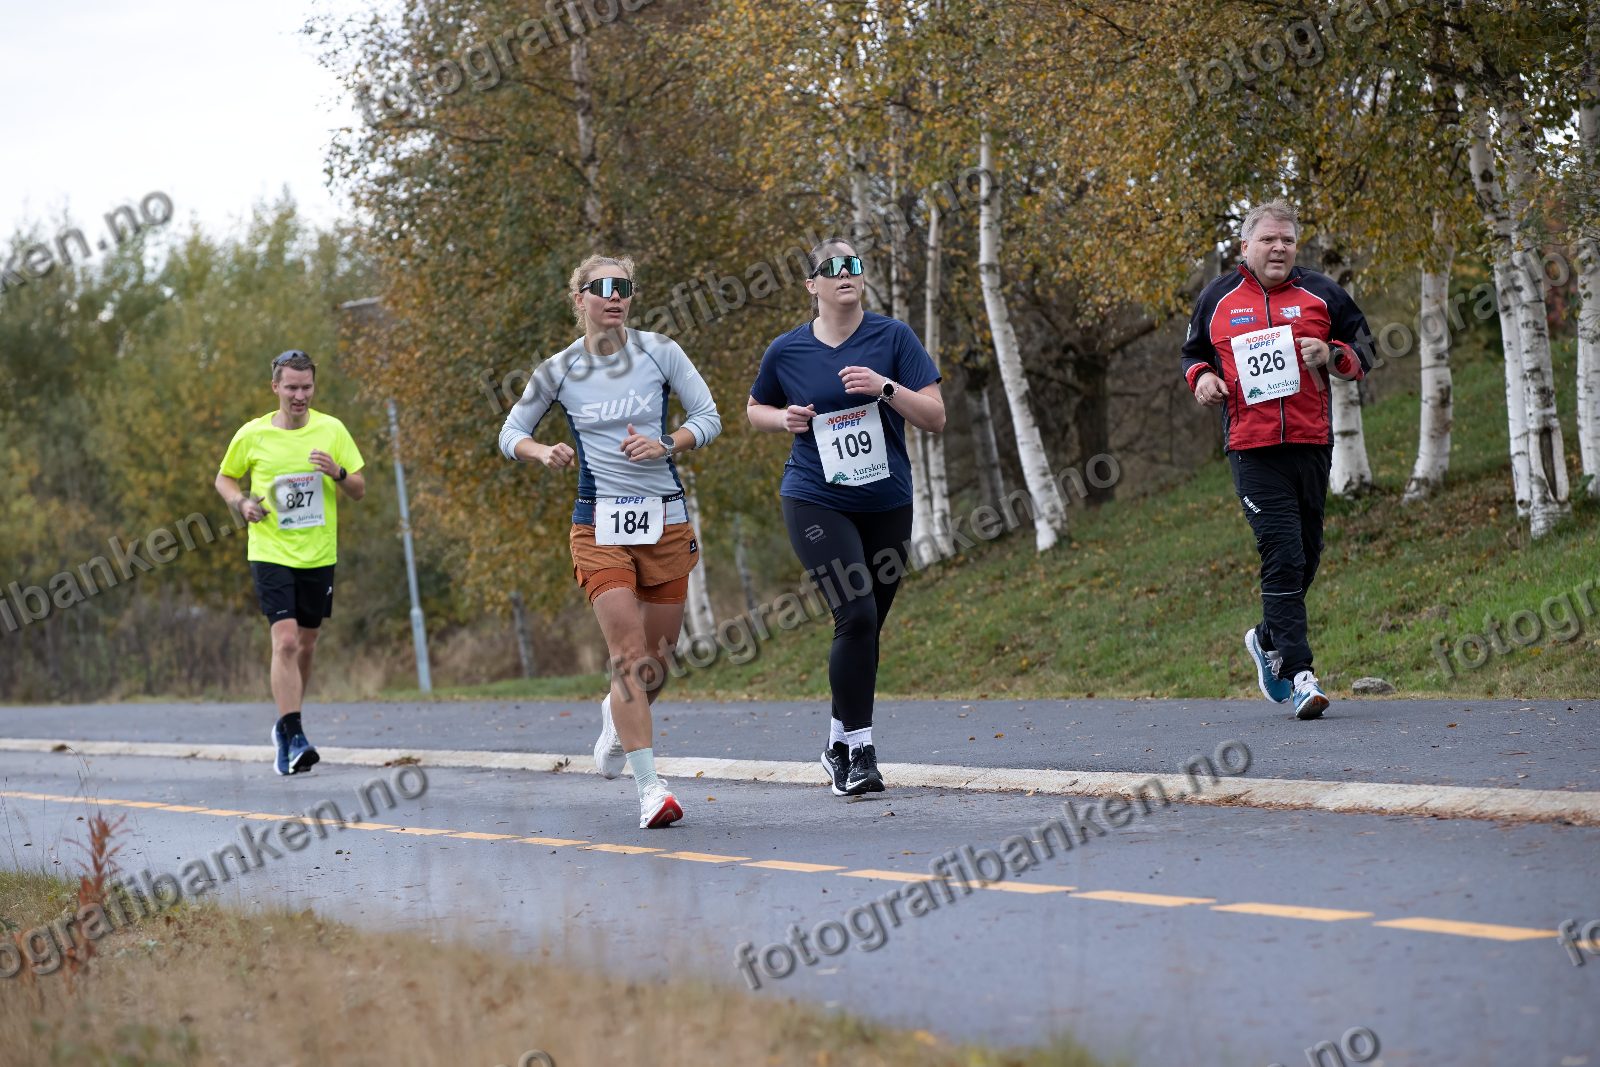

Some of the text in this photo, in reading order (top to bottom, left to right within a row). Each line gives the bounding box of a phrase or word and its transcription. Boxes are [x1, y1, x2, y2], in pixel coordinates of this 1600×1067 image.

[1246, 331, 1281, 344] NORGES
[1249, 338, 1276, 351] LØPET
[1247, 349, 1286, 377] 326
[826, 409, 867, 425] NORGES
[832, 417, 862, 431] LØPET
[831, 430, 872, 460] 109
[852, 462, 887, 477] Aurskog
[286, 490, 314, 509] 827
[614, 496, 647, 505] LØPET
[610, 510, 650, 535] 184
